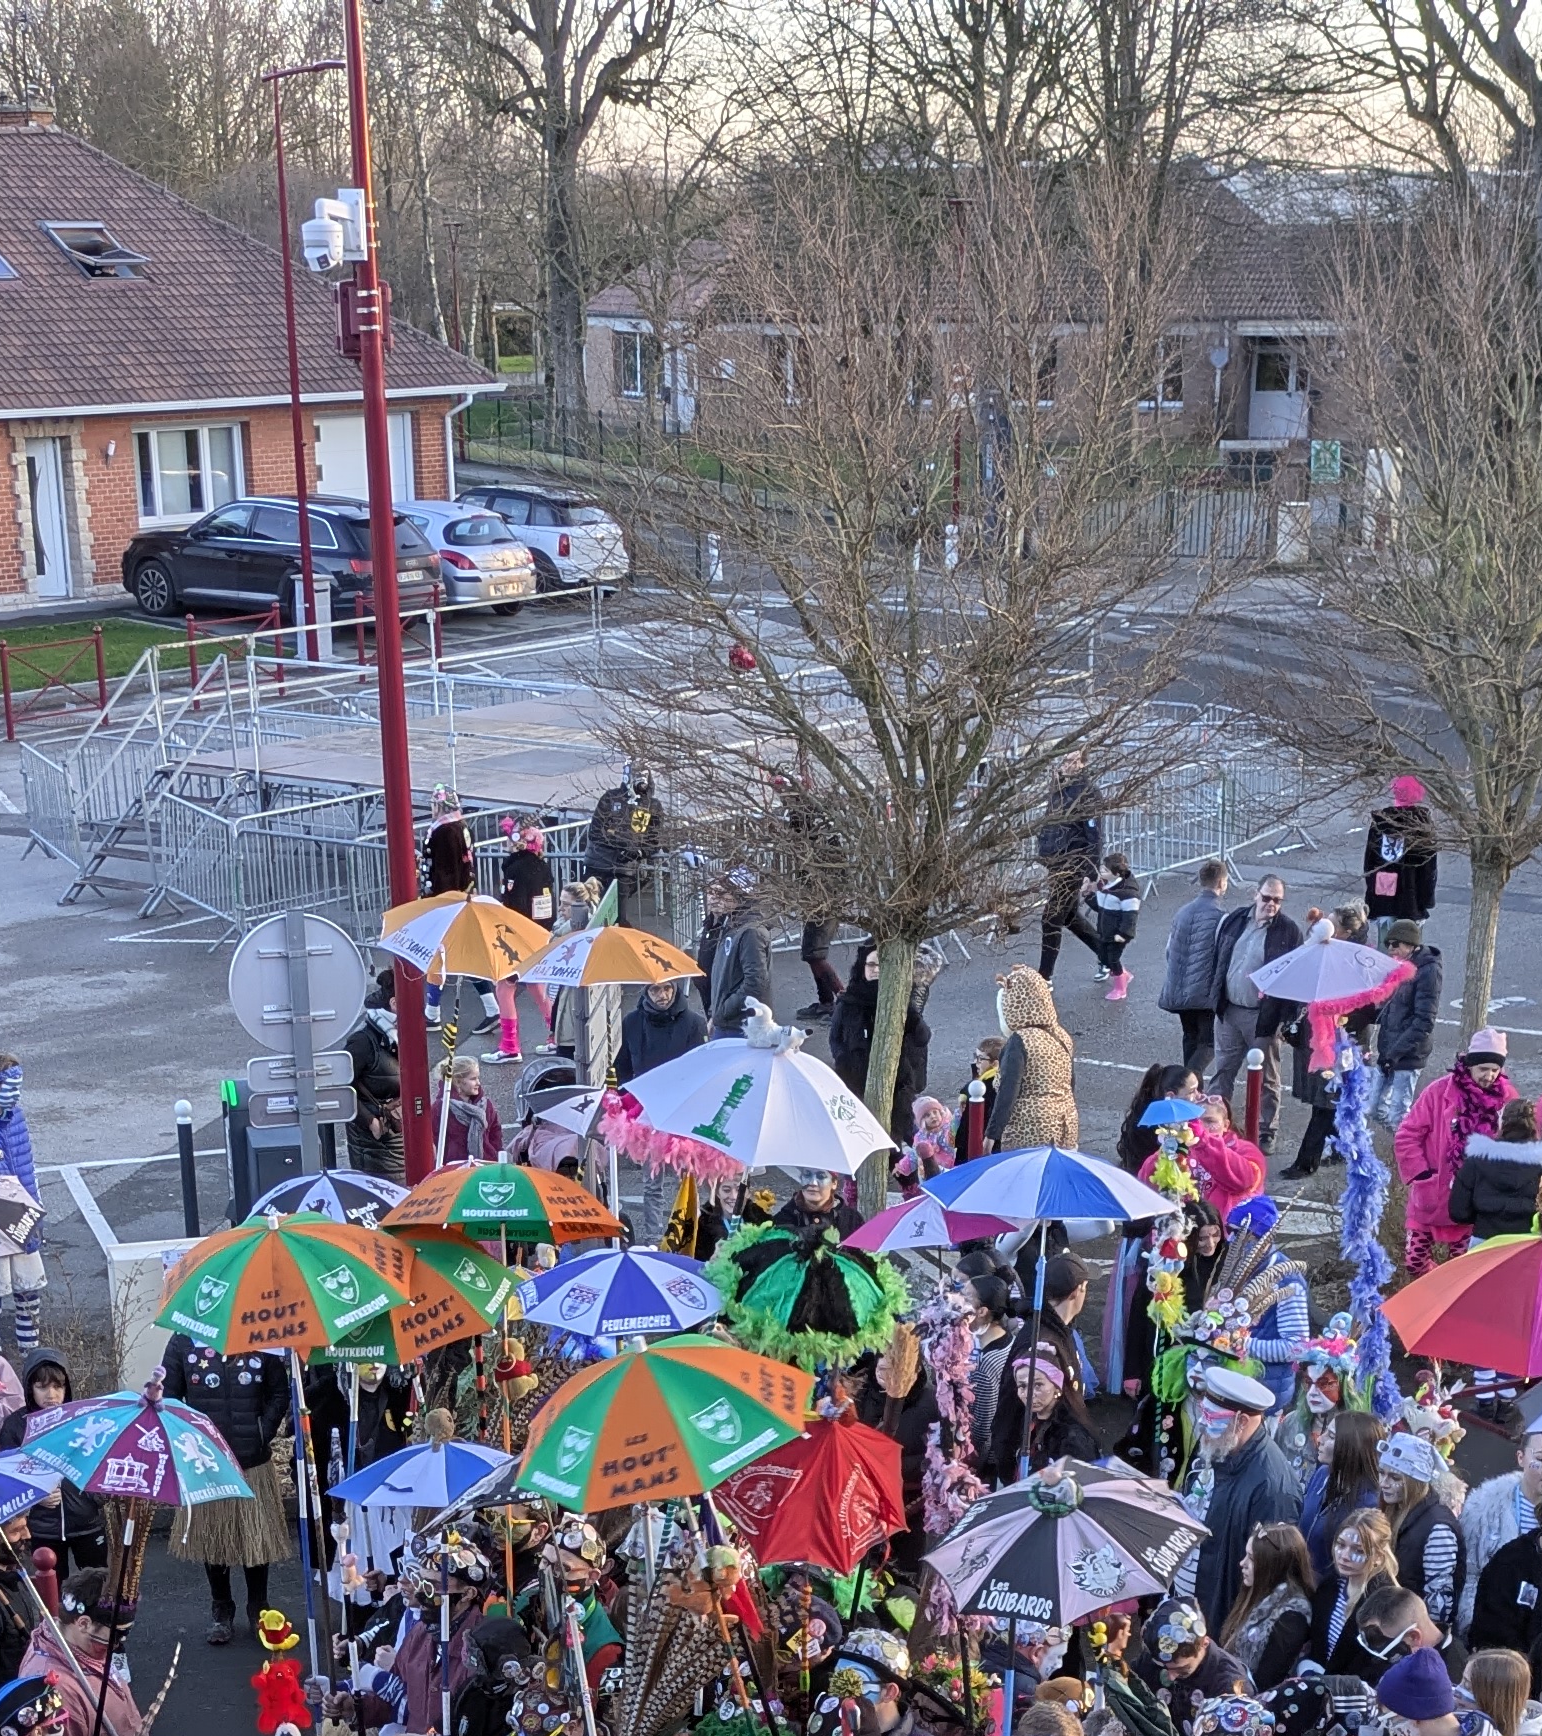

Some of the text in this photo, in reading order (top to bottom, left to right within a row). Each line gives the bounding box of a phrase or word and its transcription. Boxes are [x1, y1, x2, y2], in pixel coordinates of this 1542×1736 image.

[462, 1208, 529, 1217] HOUTKERQUE
[561, 1207, 601, 1218] MANS
[241, 1301, 306, 1325] HOUT'
[334, 1293, 390, 1329] HOUTKERQUE
[400, 1295, 455, 1332] HOUT'
[171, 1311, 220, 1339] HOUTKERQUE
[248, 1321, 308, 1345] MANS
[414, 1313, 465, 1349] MANS
[602, 1315, 671, 1332] PEULEMEUCHES
[325, 1346, 385, 1358] HOUTKERQUE
[612, 1466, 680, 1498] MANS
[1141, 1547, 1156, 1562] Les
[1150, 1526, 1198, 1577] LOUBARDS
[990, 1578, 1009, 1591] Les
[977, 1589, 1053, 1620] LOUBARDS
